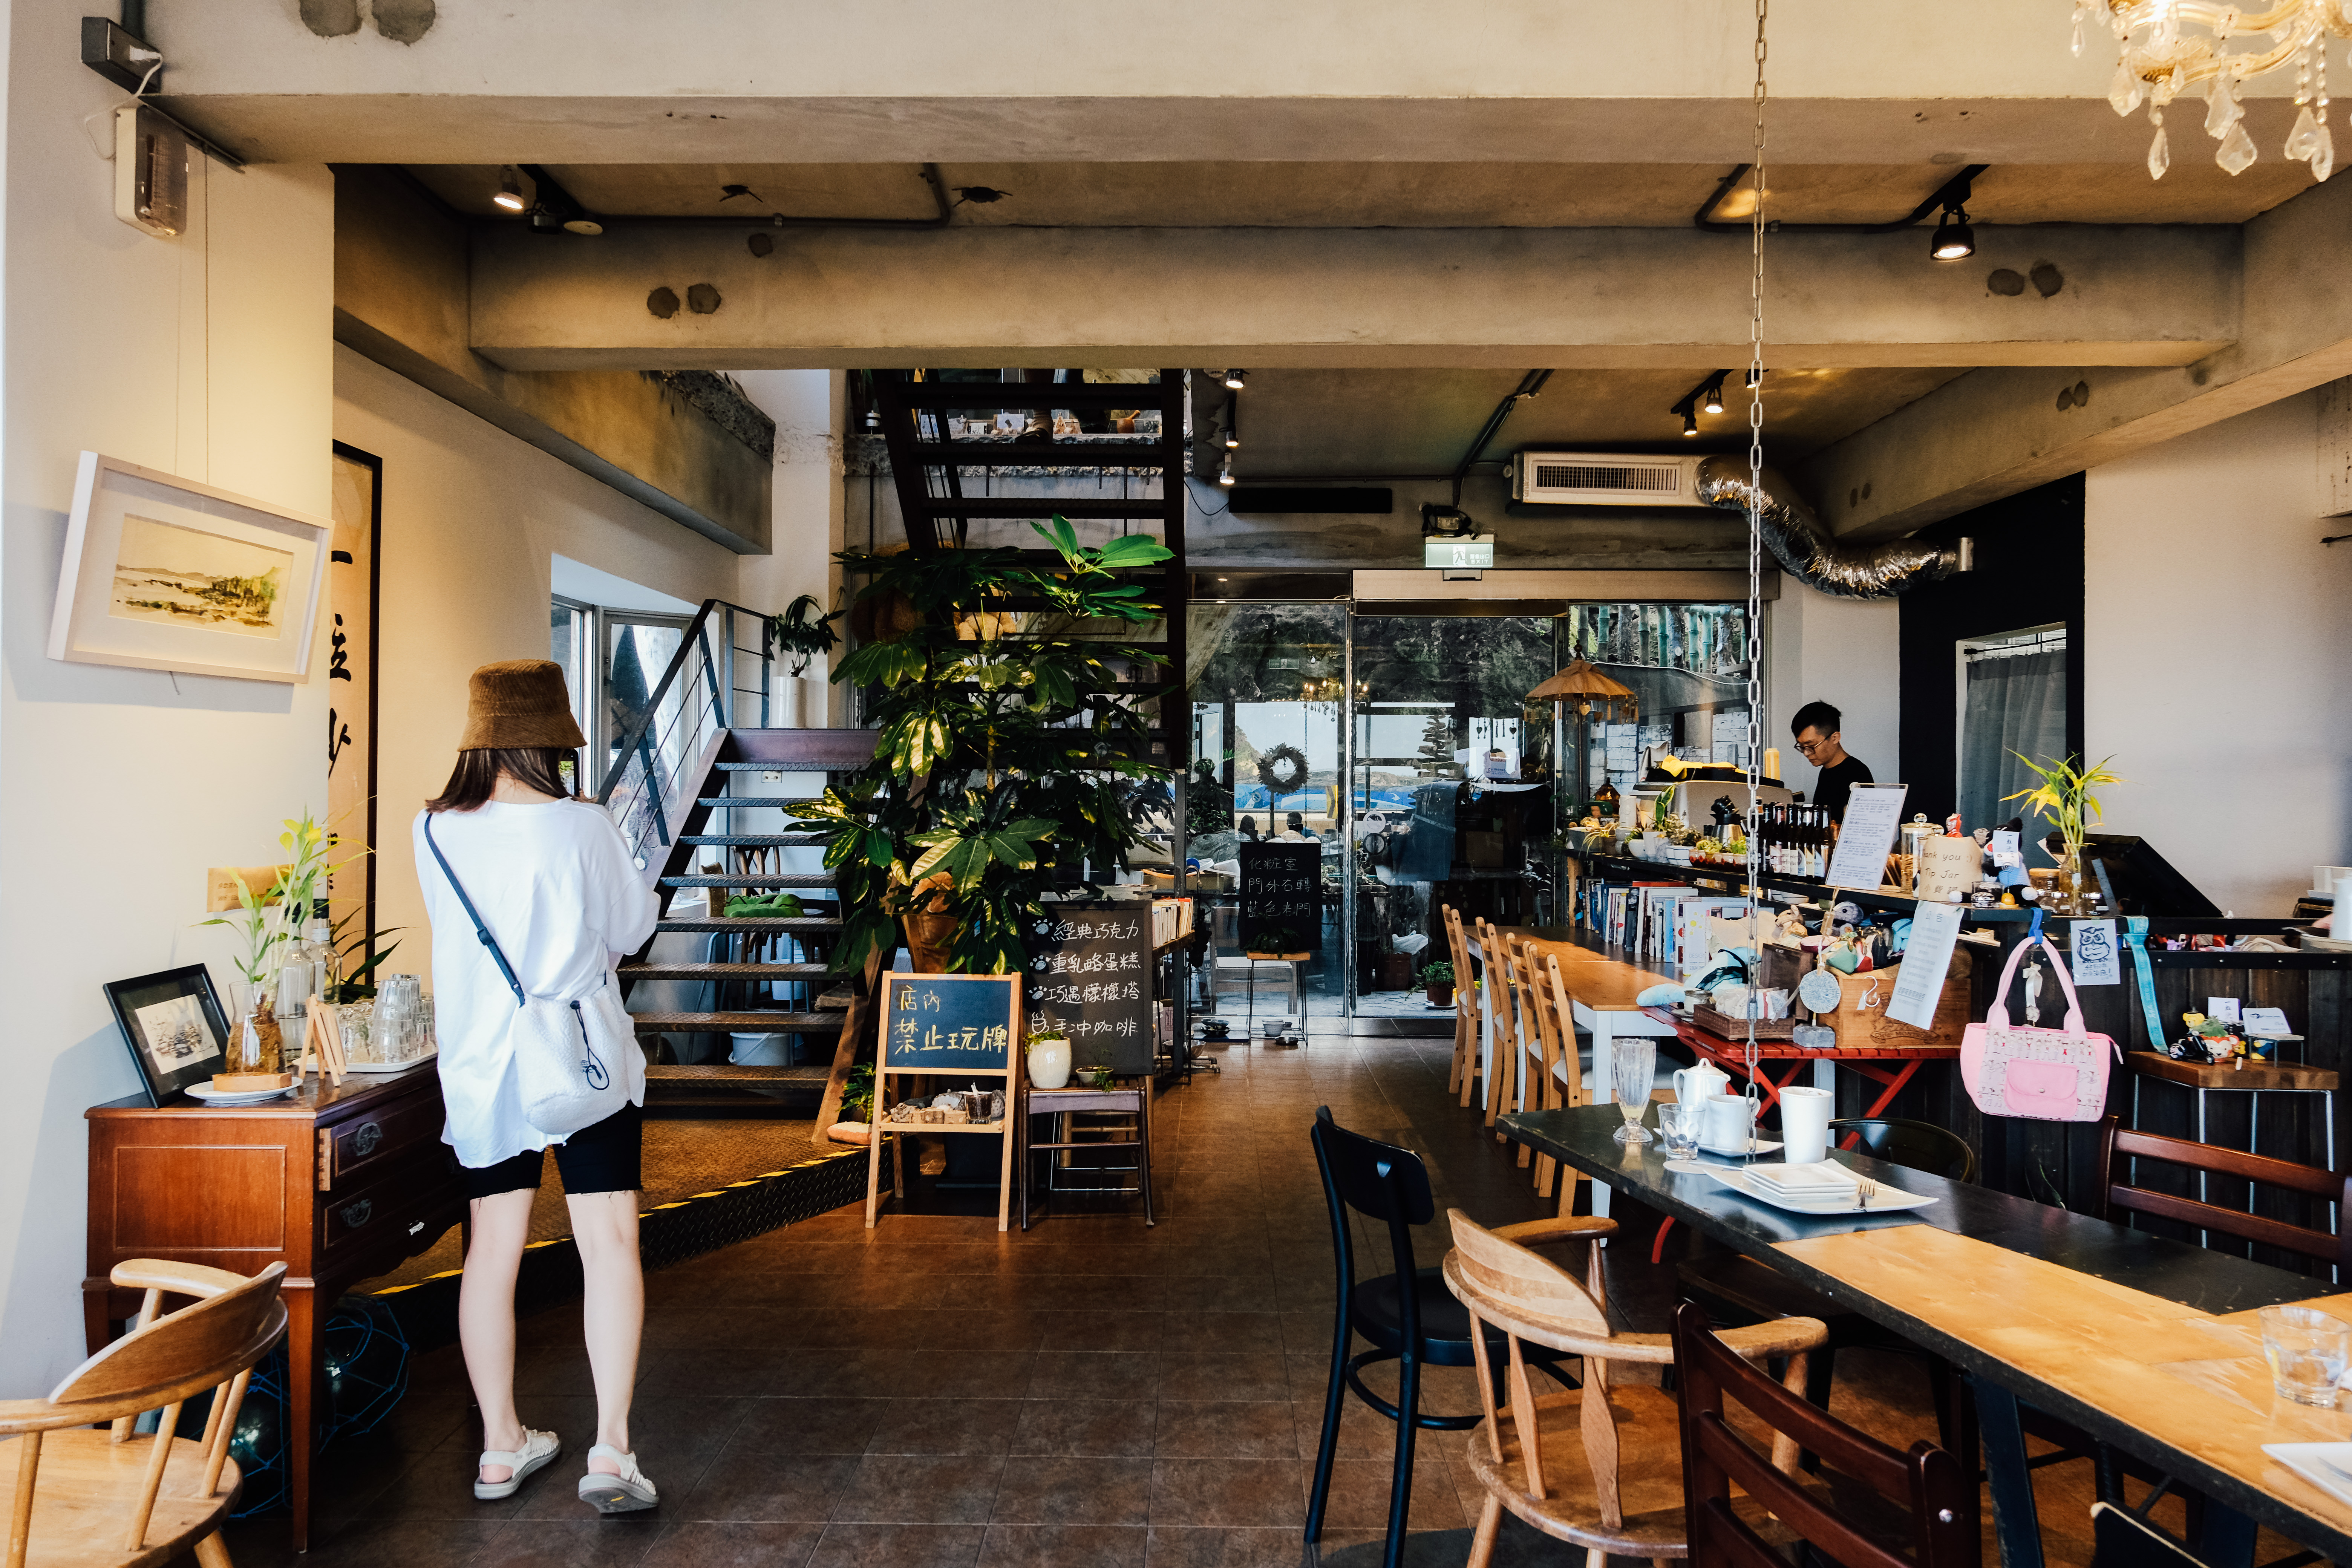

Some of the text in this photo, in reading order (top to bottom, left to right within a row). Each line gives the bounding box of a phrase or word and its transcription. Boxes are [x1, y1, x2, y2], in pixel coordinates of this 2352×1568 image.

[1942, 854, 1961, 862] you
[1925, 868, 1960, 879] Tip Jar
[1248, 876, 1312, 894] 門外右轉
[1248, 900, 1311, 918] 藍色老門
[1925, 910, 1943, 923] 公告
[1051, 919, 1139, 942] 經典巧克力
[1049, 951, 1141, 974] 重乳酪蛋糕
[894, 1017, 1008, 1055] 禁止玩牌
